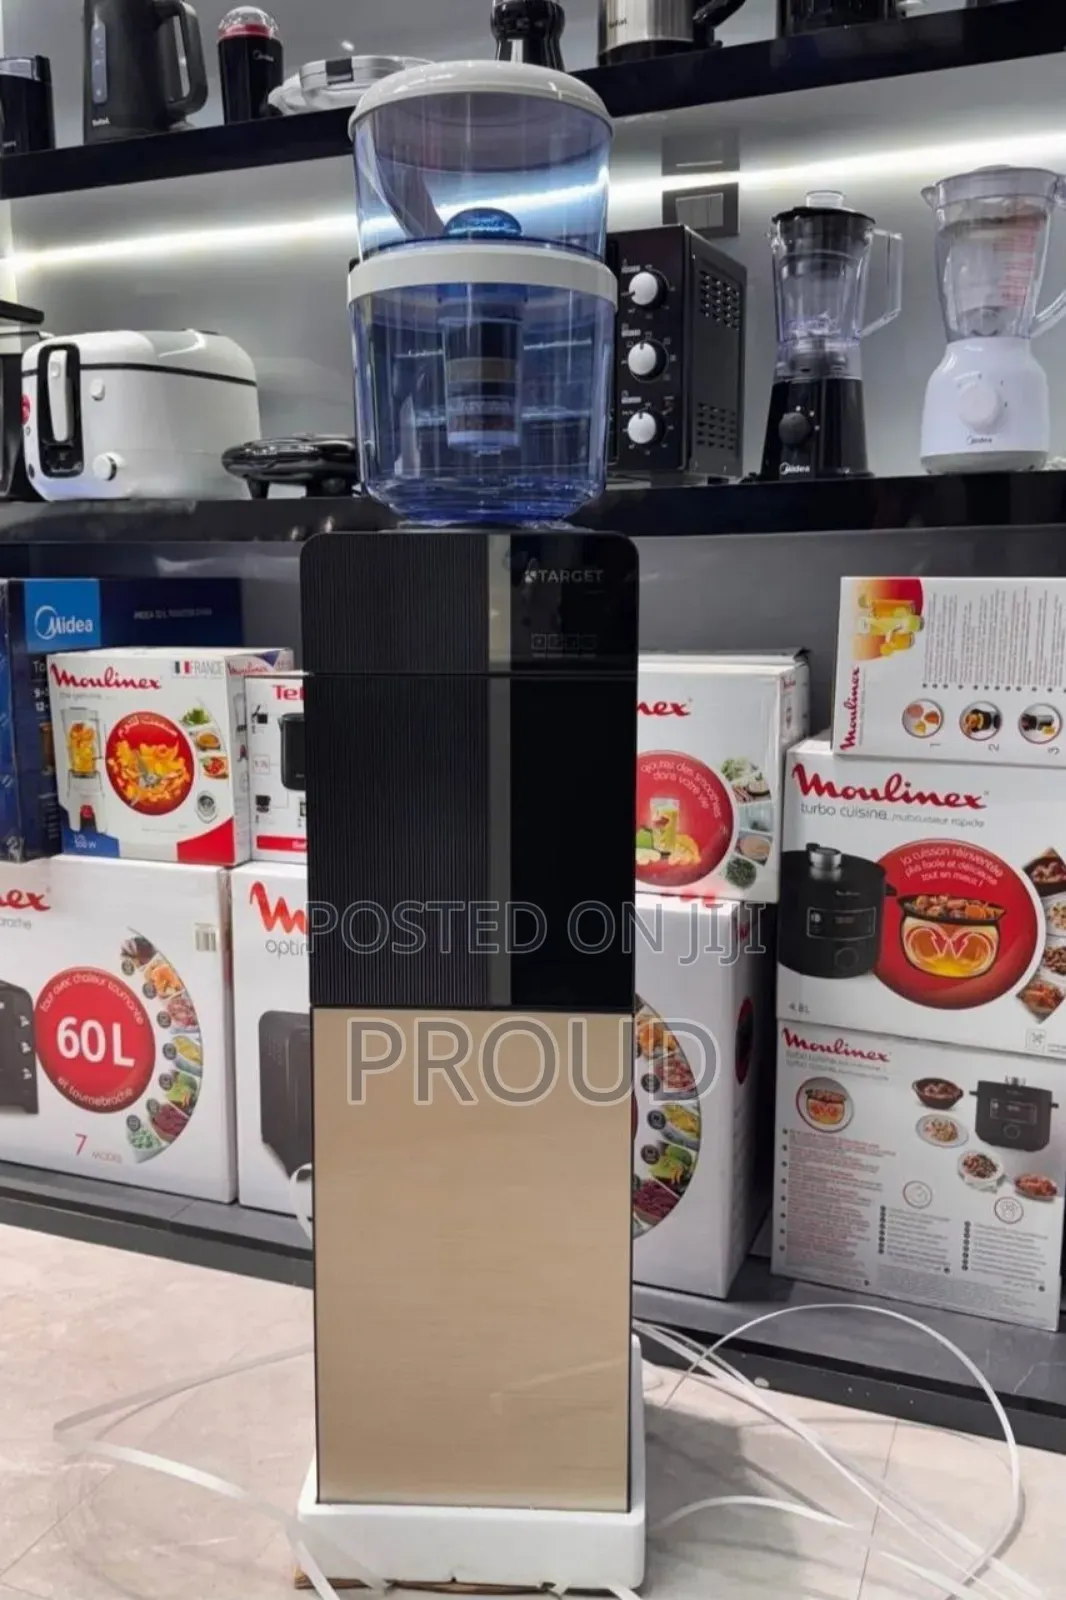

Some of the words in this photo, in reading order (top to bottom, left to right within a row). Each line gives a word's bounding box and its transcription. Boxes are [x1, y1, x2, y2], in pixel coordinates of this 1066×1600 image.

[779, 461, 810, 476] Midea
[539, 570, 604, 583] TARGET
[34, 605, 93, 640] Midea
[191, 661, 224, 674] FRANCE
[50, 663, 162, 690] Moulinex
[839, 666, 860, 750] Moulinex
[988, 744, 1000, 752] 2
[1047, 747, 1060, 755] 3
[791, 761, 987, 810] Moulinex
[800, 802, 836, 817] turbo
[912, 846, 950, 861] cuisson
[922, 859, 945, 869] facile
[947, 860, 957, 868] et
[921, 871, 938, 881] tout
[940, 871, 952, 879] en
[0, 889, 52, 912] ex
[781, 1027, 890, 1062] Moulinex
[74, 1133, 88, 1156] 7
